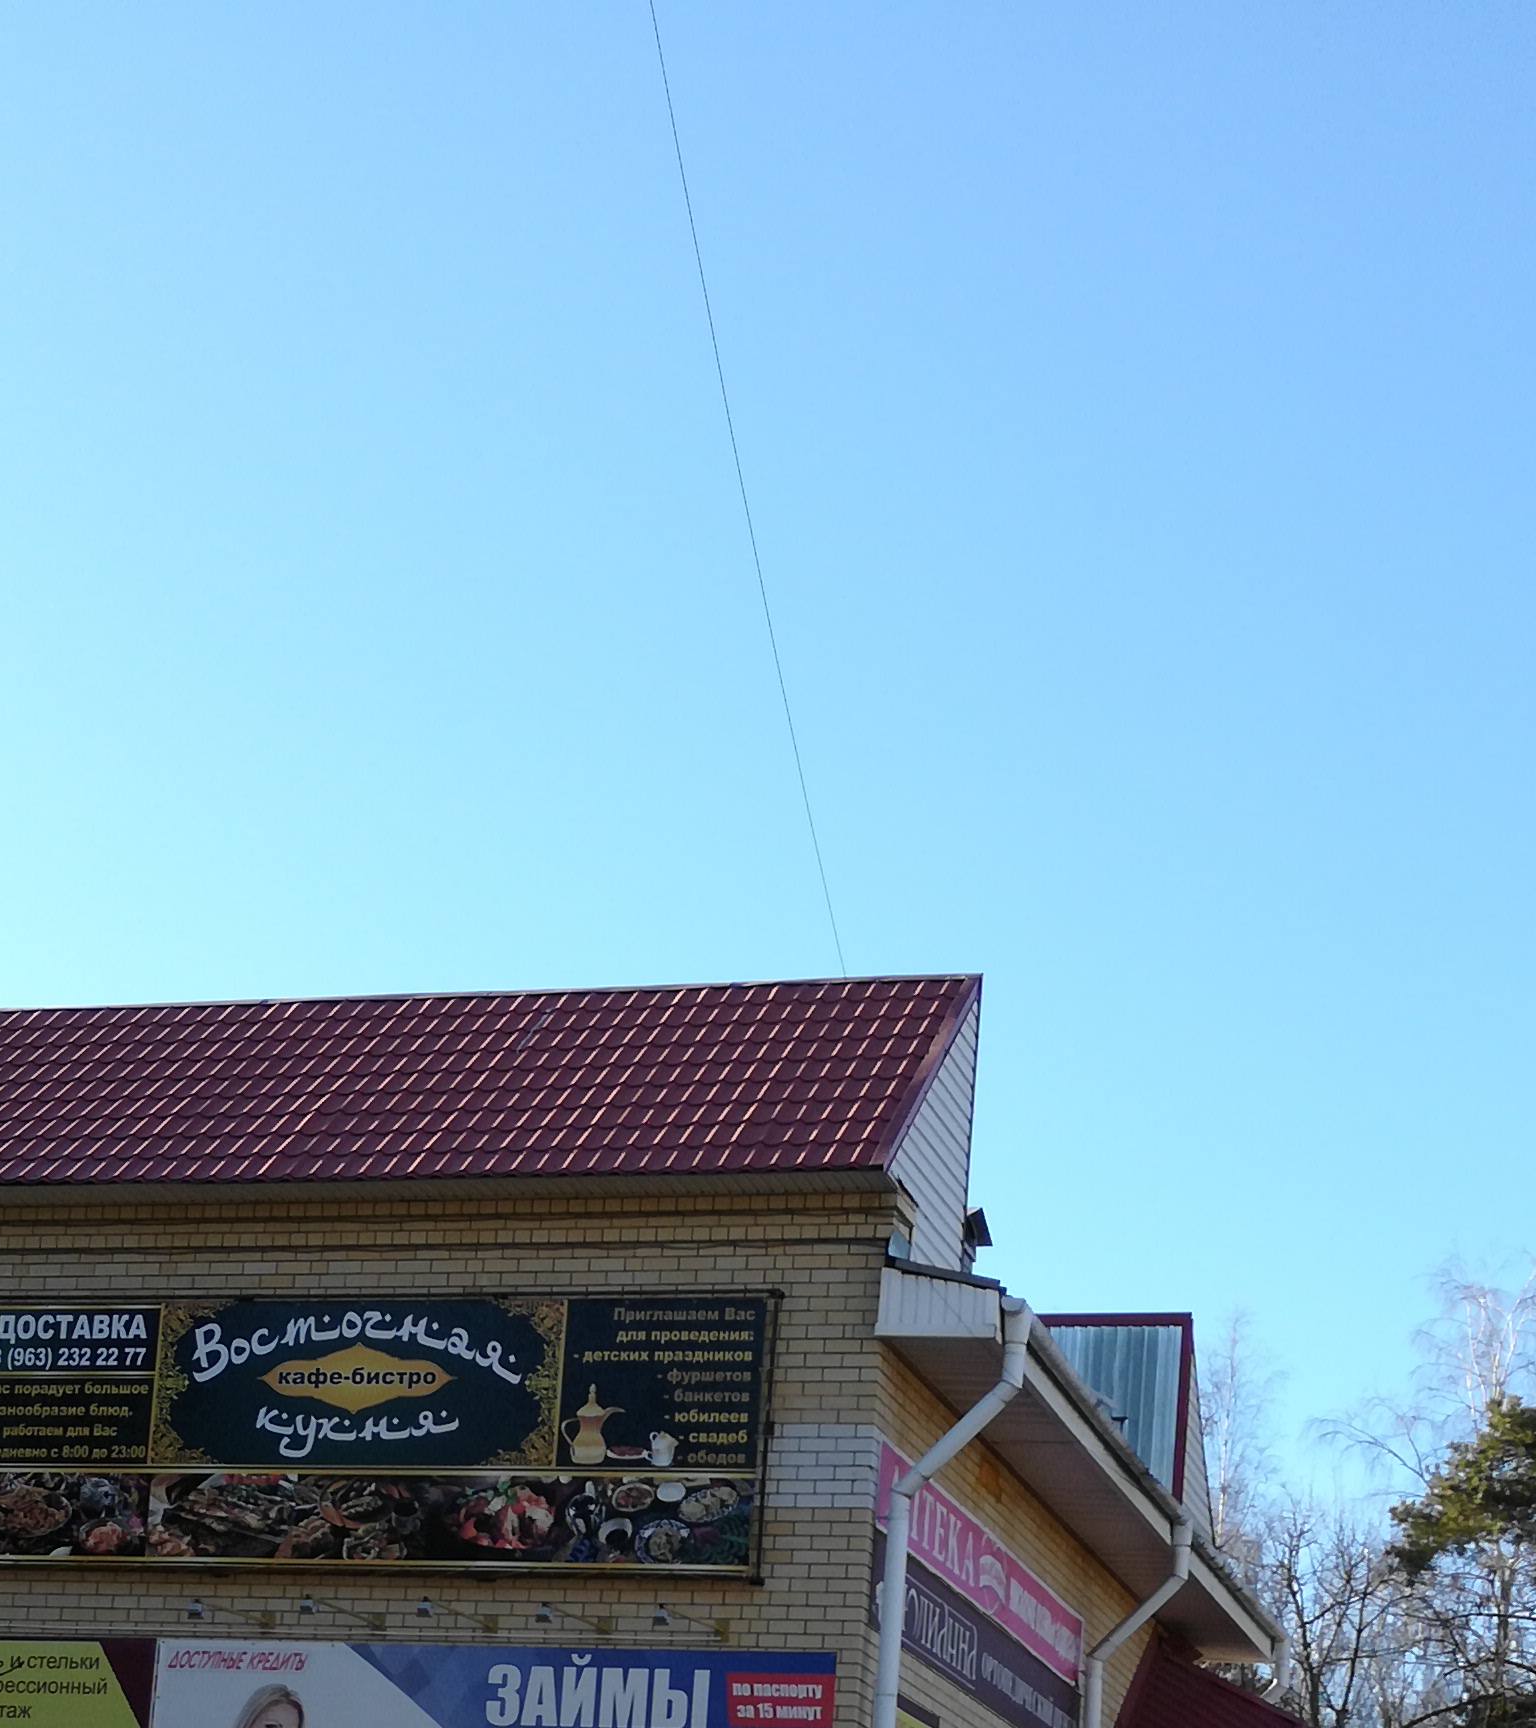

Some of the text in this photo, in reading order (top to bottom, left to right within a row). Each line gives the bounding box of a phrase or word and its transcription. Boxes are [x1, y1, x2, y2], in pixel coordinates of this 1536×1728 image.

[613, 1307, 756, 1323] Приглашаем Вас
[616, 1330, 754, 1344] для проведения:
[191, 1310, 524, 1384] Восточная
[7, 1347, 53, 1370] (963)
[57, 1348, 91, 1366] 232
[95, 1348, 118, 1366] 22
[124, 1347, 147, 1366] 77
[582, 1351, 649, 1363] детских
[654, 1351, 753, 1364] праздников
[277, 1367, 437, 1388] кафе-бистро
[667, 1368, 751, 1384] фуршетов
[14, 1384, 81, 1397] порадует
[84, 1381, 149, 1394] большое
[674, 1389, 750, 1402] банкетов
[89, 1403, 133, 1418] блюд.
[674, 1409, 749, 1423] юбилеев
[3, 1423, 63, 1438] работаем
[66, 1426, 90, 1438] для
[93, 1424, 118, 1436] Вас
[256, 1405, 460, 1458] кухня
[688, 1430, 748, 1444] свадеб
[51, 1448, 59, 1458] с
[62, 1445, 89, 1458] 8:00
[91, 1448, 107, 1459] до
[111, 1445, 146, 1458] 23:00
[687, 1450, 746, 1465] обедов
[891, 1465, 976, 1588] ТЕКА
[27, 1656, 100, 1670] стельки
[167, 1650, 309, 1671] ДОСТУПНЫЕ КРЕДИТЫ
[732, 1683, 823, 1700] по паспорту
[736, 1703, 822, 1721] за 15 минут
